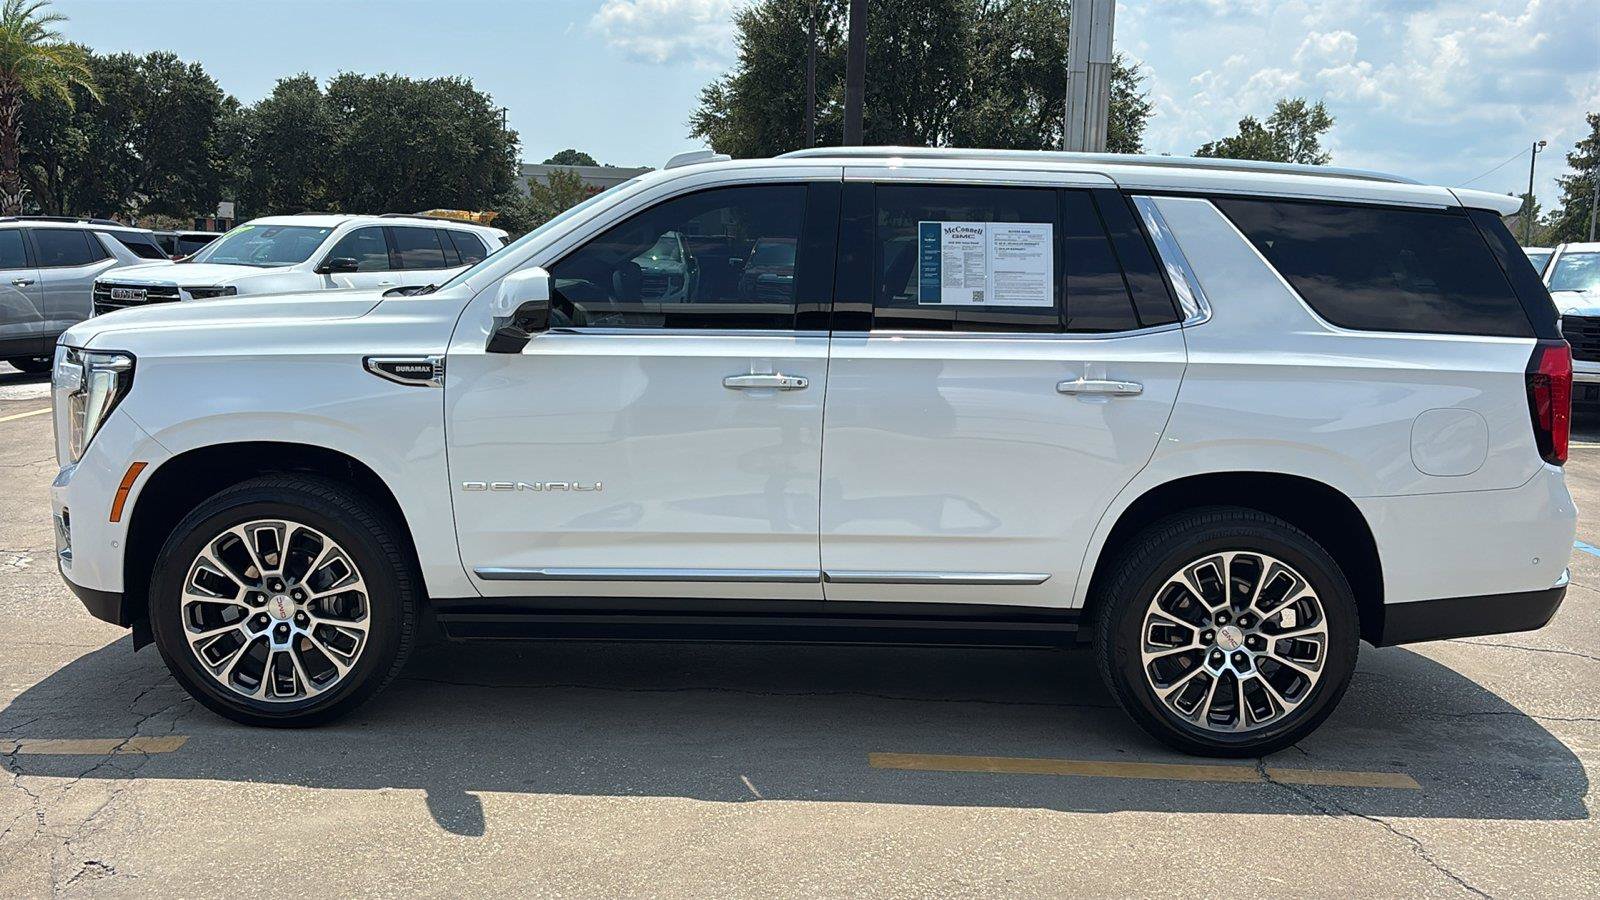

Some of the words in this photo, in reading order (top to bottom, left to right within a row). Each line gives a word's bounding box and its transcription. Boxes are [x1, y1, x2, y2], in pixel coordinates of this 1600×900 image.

[944, 226, 983, 235] McConnell
[395, 365, 431, 373] DURAMAX
[462, 481, 602, 491] DENALI
[276, 596, 287, 619] GMC
[1221, 629, 1239, 648] GMC
